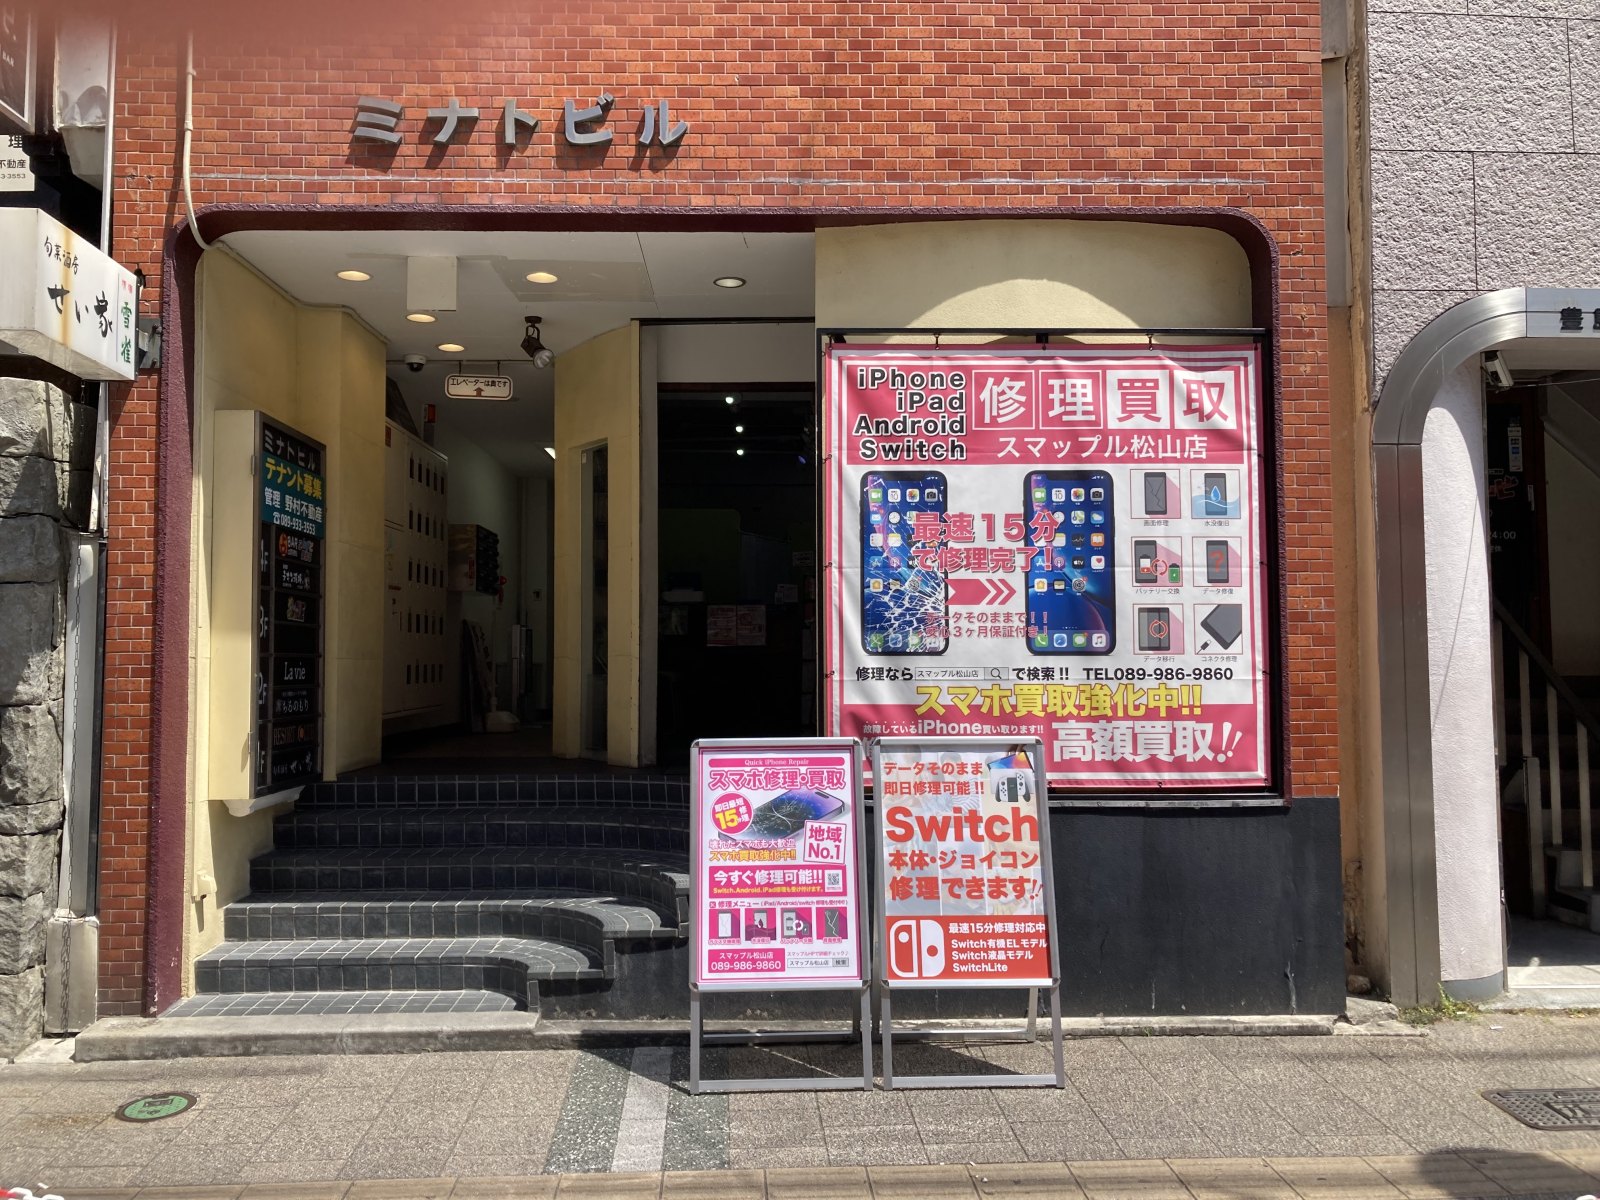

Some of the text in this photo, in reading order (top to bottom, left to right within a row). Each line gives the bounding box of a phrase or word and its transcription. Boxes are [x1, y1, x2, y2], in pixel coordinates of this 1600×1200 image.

[353, 92, 689, 145] ミナトビル
[858, 367, 966, 389] iPhone
[896, 390, 966, 412] iPad
[979, 376, 1229, 424] 修理買取
[853, 414, 966, 436] Android
[859, 438, 967, 460] Switch
[997, 434, 1208, 459] スマップル松山店
[265, 457, 322, 500] テナント募集
[265, 486, 281, 508] 管理
[912, 511, 1060, 543] 最速15分
[911, 547, 1053, 573] で修理完了!
[1135, 587, 1180, 595] バッテリー交換
[856, 667, 914, 681] 修理なら
[917, 669, 979, 679] スマップル松山店
[1083, 667, 1234, 681] TEL089-986-9860
[914, 683, 1203, 718] スマホ買取強化中!!
[1051, 720, 1243, 763] 高額買取!!
[745, 758, 809, 767] Quick iPhone Repair
[884, 762, 983, 775] データそのまま
[708, 768, 846, 790] スマホ修理・買取
[808, 824, 842, 843] 地域
[886, 806, 1039, 843] Switch
[808, 843, 841, 860] No.1
[888, 850, 1039, 871] 本体・ジョイコン
[713, 869, 823, 886] 今すぐ修理可能!!
[948, 922, 1046, 934] 最速15分修理対応中
[711, 961, 782, 971] 089-986-9860
[719, 951, 774, 960] スマップル松山店
